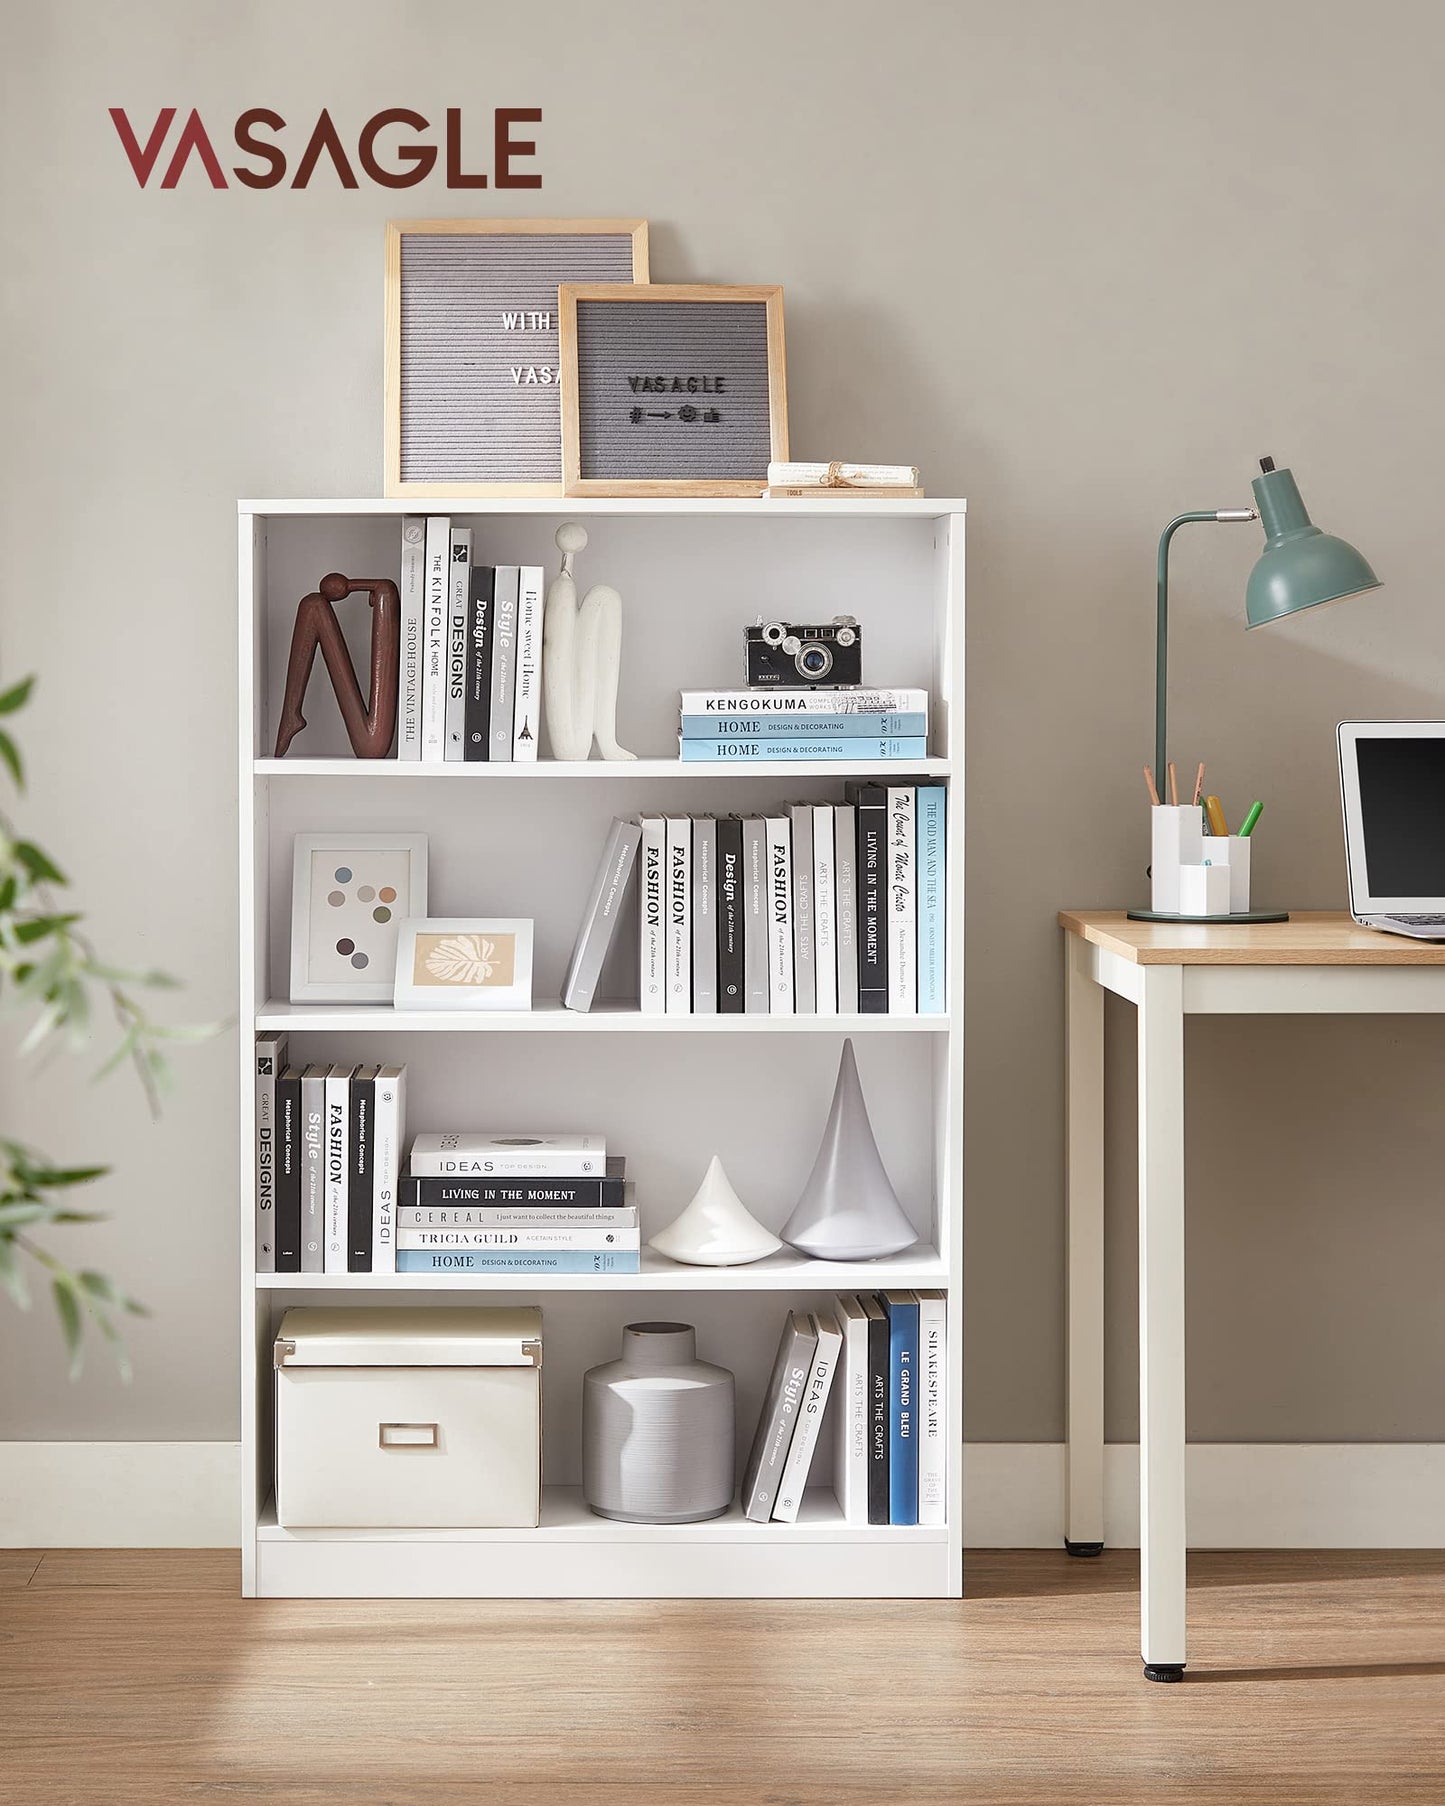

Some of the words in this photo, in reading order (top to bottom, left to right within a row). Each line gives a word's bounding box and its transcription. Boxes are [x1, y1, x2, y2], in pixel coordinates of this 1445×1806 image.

[503, 312, 550, 330] WITH
[628, 375, 726, 394] VASAGLE
[433, 554, 442, 572] THE
[430, 577, 442, 648] KINFOLK
[525, 590, 537, 626] Home
[472, 600, 487, 648] Design
[498, 601, 514, 647] Style
[406, 618, 417, 660] HOUSE
[524, 630, 534, 660] sweet
[430, 652, 439, 677] HOME
[451, 615, 464, 699] DESIGNS
[476, 652, 483, 660] of
[500, 654, 507, 662] of
[406, 662, 416, 714] VINTAGE
[522, 664, 535, 698] Home
[706, 699, 807, 710] KENGOKUMA
[406, 717, 415, 742] THE
[718, 721, 761, 733] HOME
[717, 744, 760, 756] HOME
[767, 746, 792, 754] DESIGN
[792, 746, 798, 754] &
[800, 746, 843, 754] DECORATING
[895, 794, 910, 810] The
[927, 802, 937, 818] THE
[893, 812, 910, 838] Count
[927, 819, 937, 836] OLD
[867, 831, 877, 868] LIVING
[890, 838, 906, 848] of
[926, 838, 936, 857] MAN
[613, 844, 630, 886] Metaphorical
[723, 854, 736, 901] Design
[820, 861, 828, 886] ARTS
[842, 860, 850, 884] ARTS
[894, 852, 909, 882] Monte
[926, 859, 936, 876] AND
[648, 846, 659, 926] FASHION
[673, 846, 684, 926] FASHION
[774, 844, 787, 924] FASHION
[867, 874, 876, 884] IN
[927, 877, 936, 894] THE
[603, 888, 617, 917] Concepts
[800, 874, 808, 910] CRAFTS
[820, 890, 828, 907] THE
[842, 889, 850, 906] THE
[867, 890, 877, 912] THE
[892, 884, 910, 912] Cristo
[926, 894, 936, 909] SEA
[727, 904, 734, 913] of
[800, 915, 808, 932] THE
[820, 911, 828, 946] CRAFTS
[842, 910, 850, 946] CRAFTS
[800, 936, 808, 960] ARTS
[867, 916, 877, 965] MOMENT
[305, 1113, 320, 1159] Style
[330, 1104, 342, 1184] FASHION
[260, 1128, 272, 1210] DESIGNS
[310, 1166, 316, 1174] of
[440, 1162, 494, 1172] IDEAS
[442, 1188, 480, 1200] LIVING
[484, 1190, 496, 1200] IN
[500, 1190, 523, 1200] THE
[528, 1190, 576, 1200] MOMENT
[380, 1190, 391, 1244] IDEAS
[415, 1212, 484, 1222] CEREAL
[596, 1214, 614, 1222] things
[418, 1234, 469, 1244] TRICIA
[474, 1234, 518, 1244] GUILD
[432, 1256, 474, 1267] HOME
[901, 1352, 910, 1363] LE
[782, 1368, 804, 1414] Style
[807, 1361, 828, 1414] IDEAS
[855, 1373, 863, 1398] ARTS
[875, 1374, 883, 1398] ARTS
[900, 1370, 910, 1406] GRAND
[928, 1330, 938, 1438] SHAKESPEARE
[855, 1402, 863, 1420] THE
[875, 1403, 884, 1421] THE
[900, 1412, 910, 1438] BLEU
[855, 1423, 863, 1458] CRAFTS
[874, 1425, 884, 1460] CRAFTS
